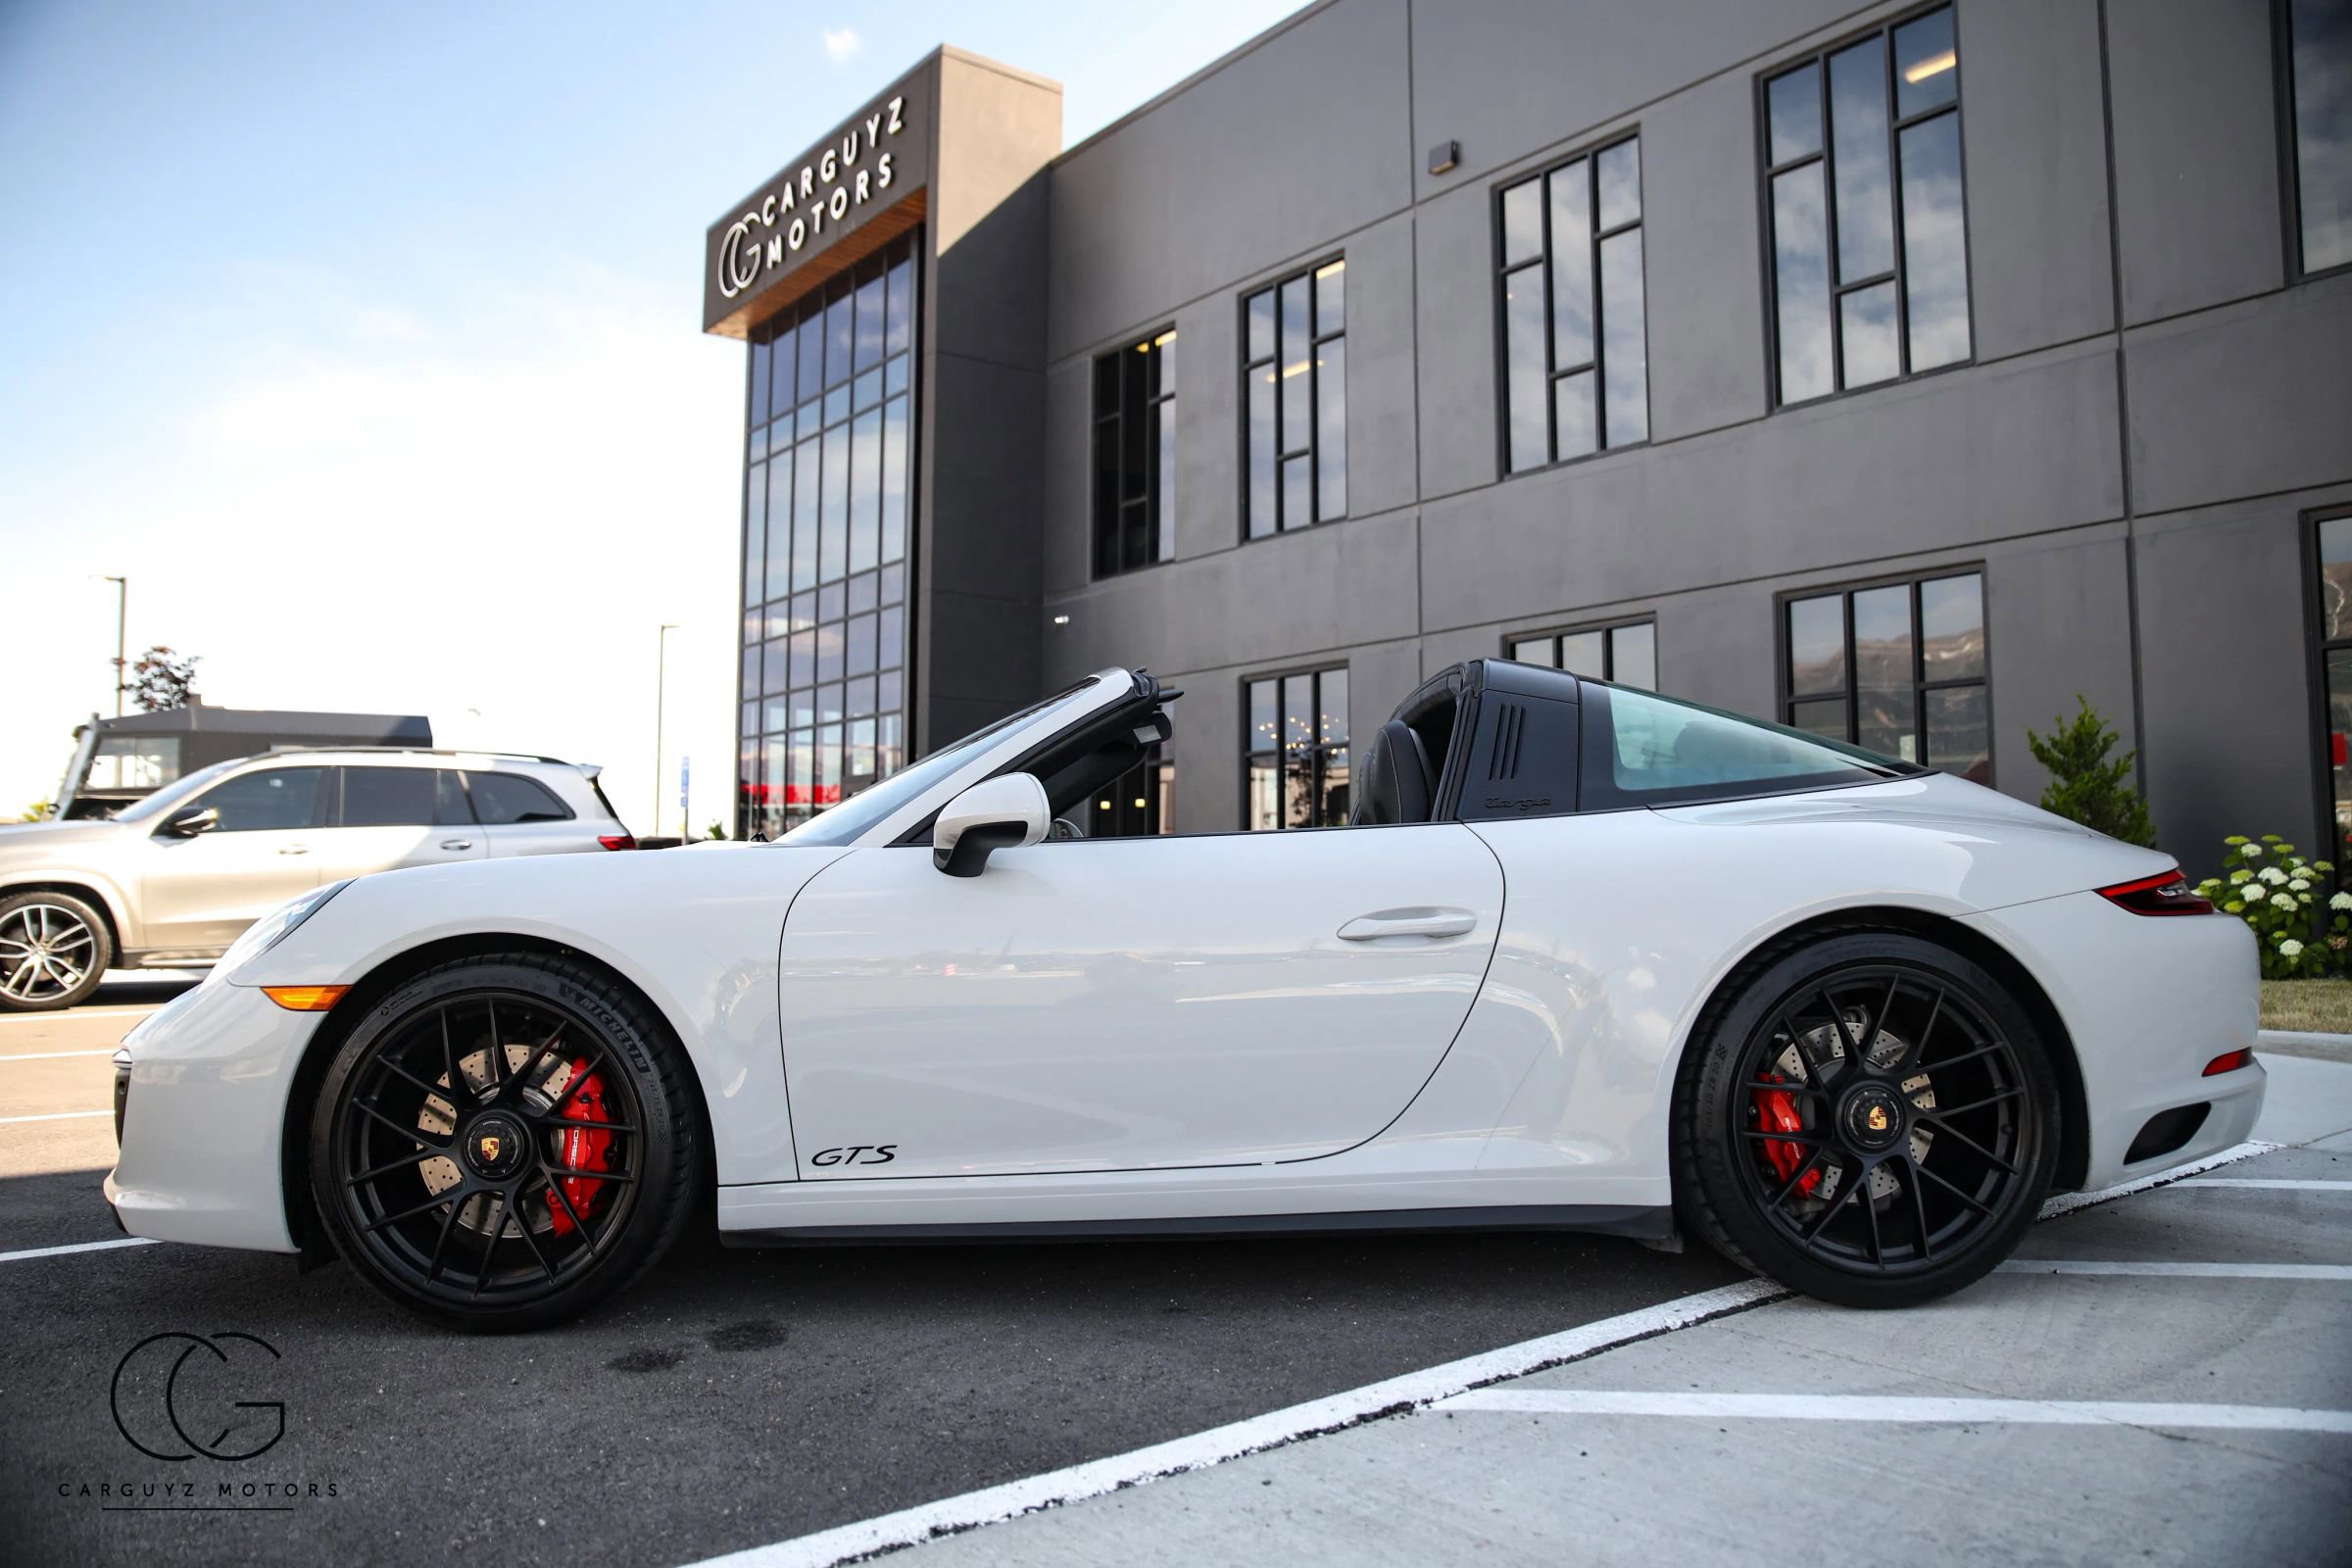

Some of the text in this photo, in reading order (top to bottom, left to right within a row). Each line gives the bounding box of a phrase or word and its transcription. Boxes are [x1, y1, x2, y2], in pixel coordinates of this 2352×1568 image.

[761, 96, 903, 226] CARGUYZ
[766, 152, 891, 270] MOTORS
[579, 998, 648, 1069] MICHELIN
[811, 1145, 899, 1167] GTS
